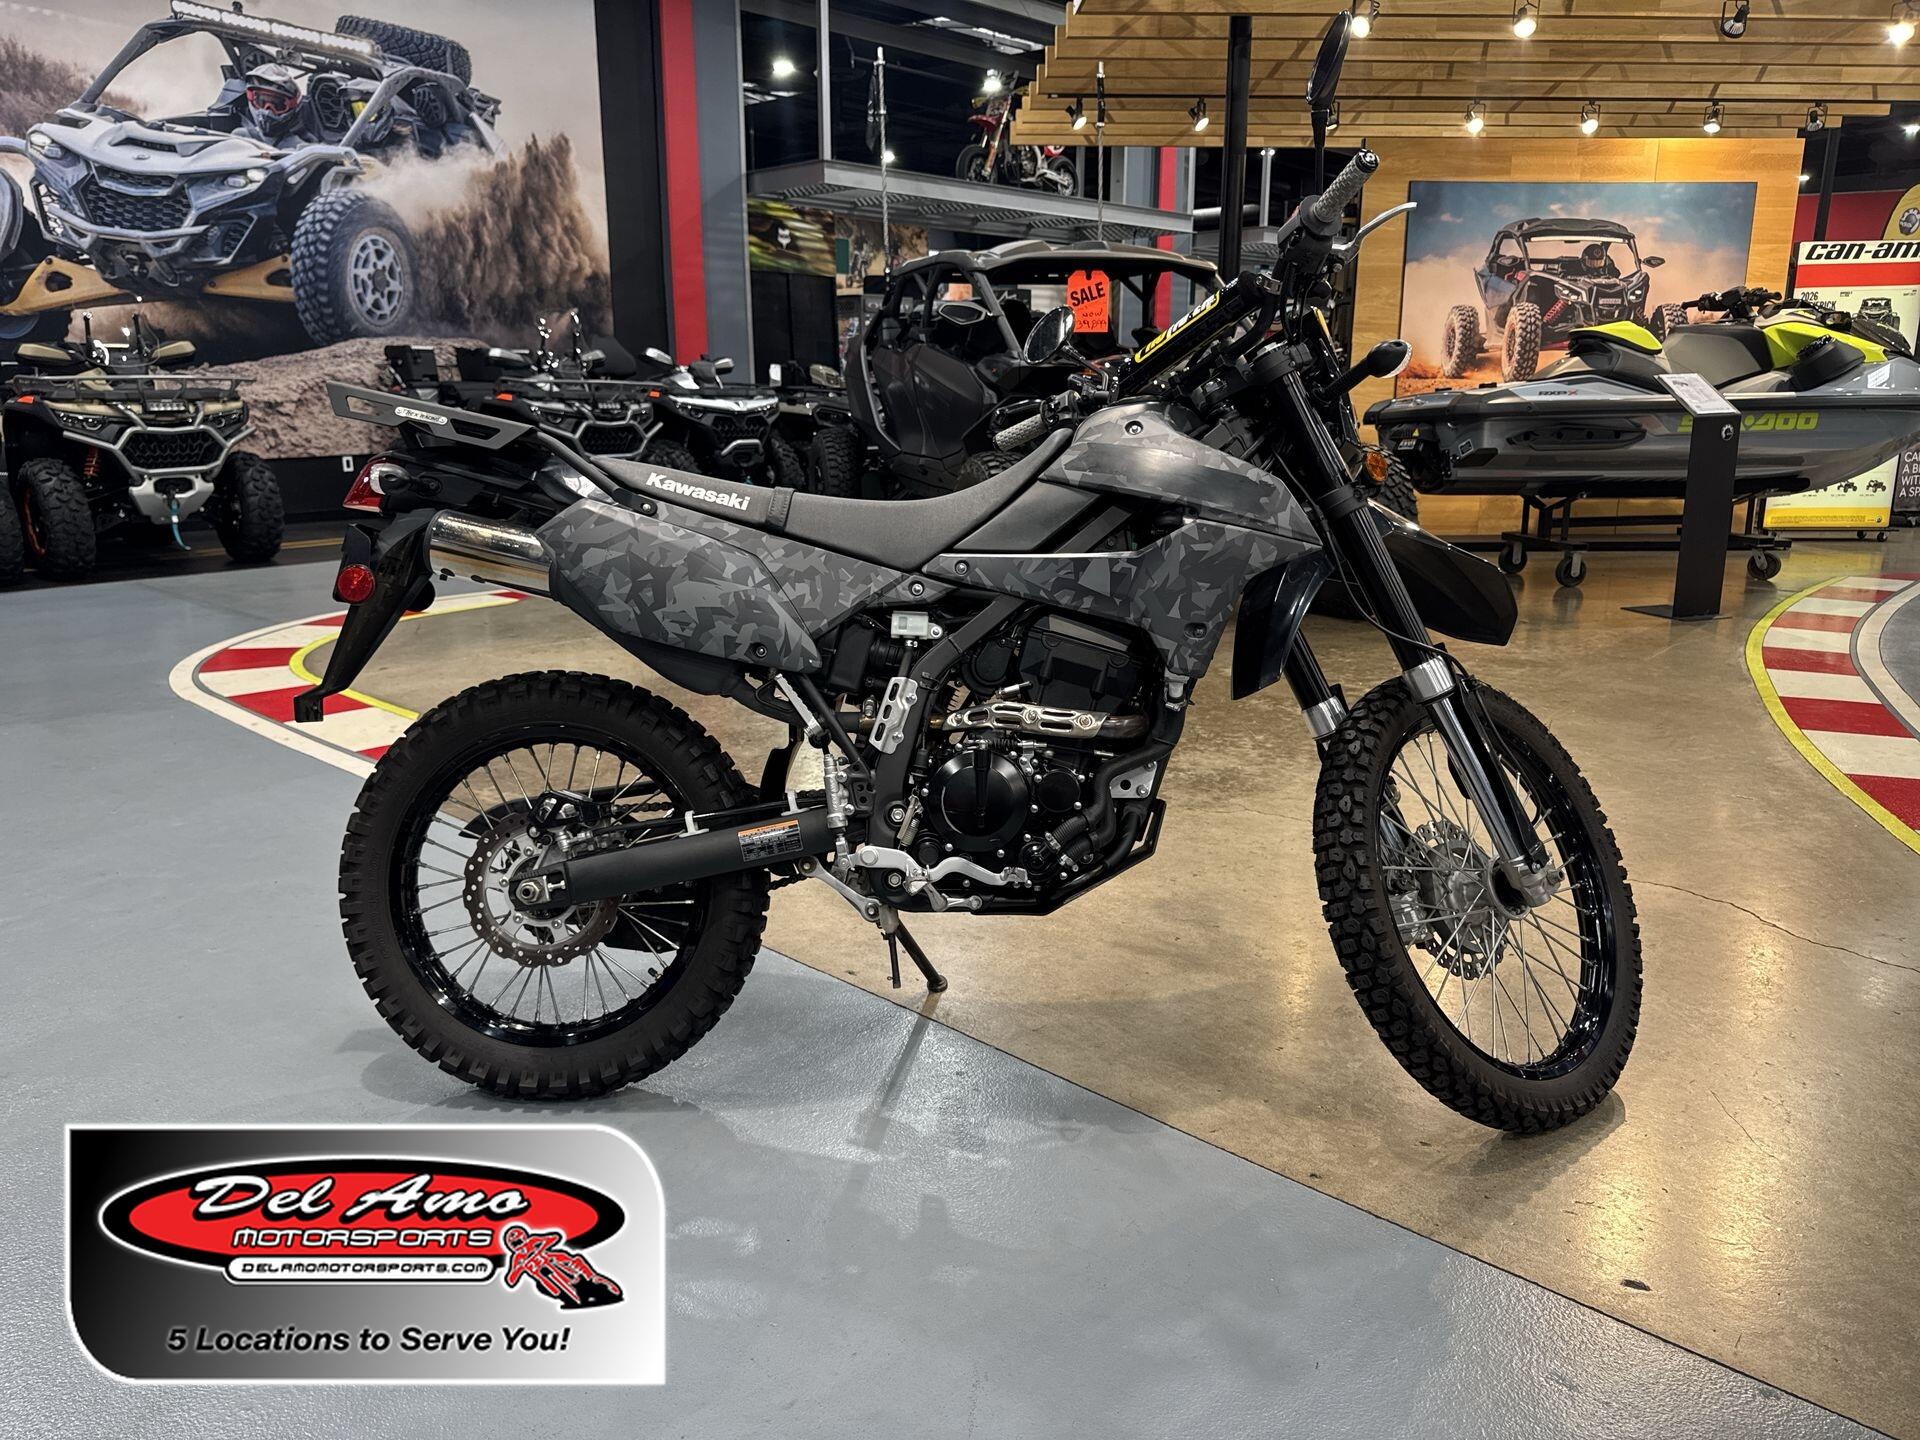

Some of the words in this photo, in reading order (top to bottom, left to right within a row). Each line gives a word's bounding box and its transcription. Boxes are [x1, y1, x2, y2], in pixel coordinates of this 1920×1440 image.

[1805, 242, 1920, 260] can-am
[1070, 281, 1105, 307] SALE
[1902, 463, 1910, 474] A
[1901, 475, 1920, 486] WIT
[645, 472, 751, 511] Kawasaki
[1899, 487, 1907, 498] A
